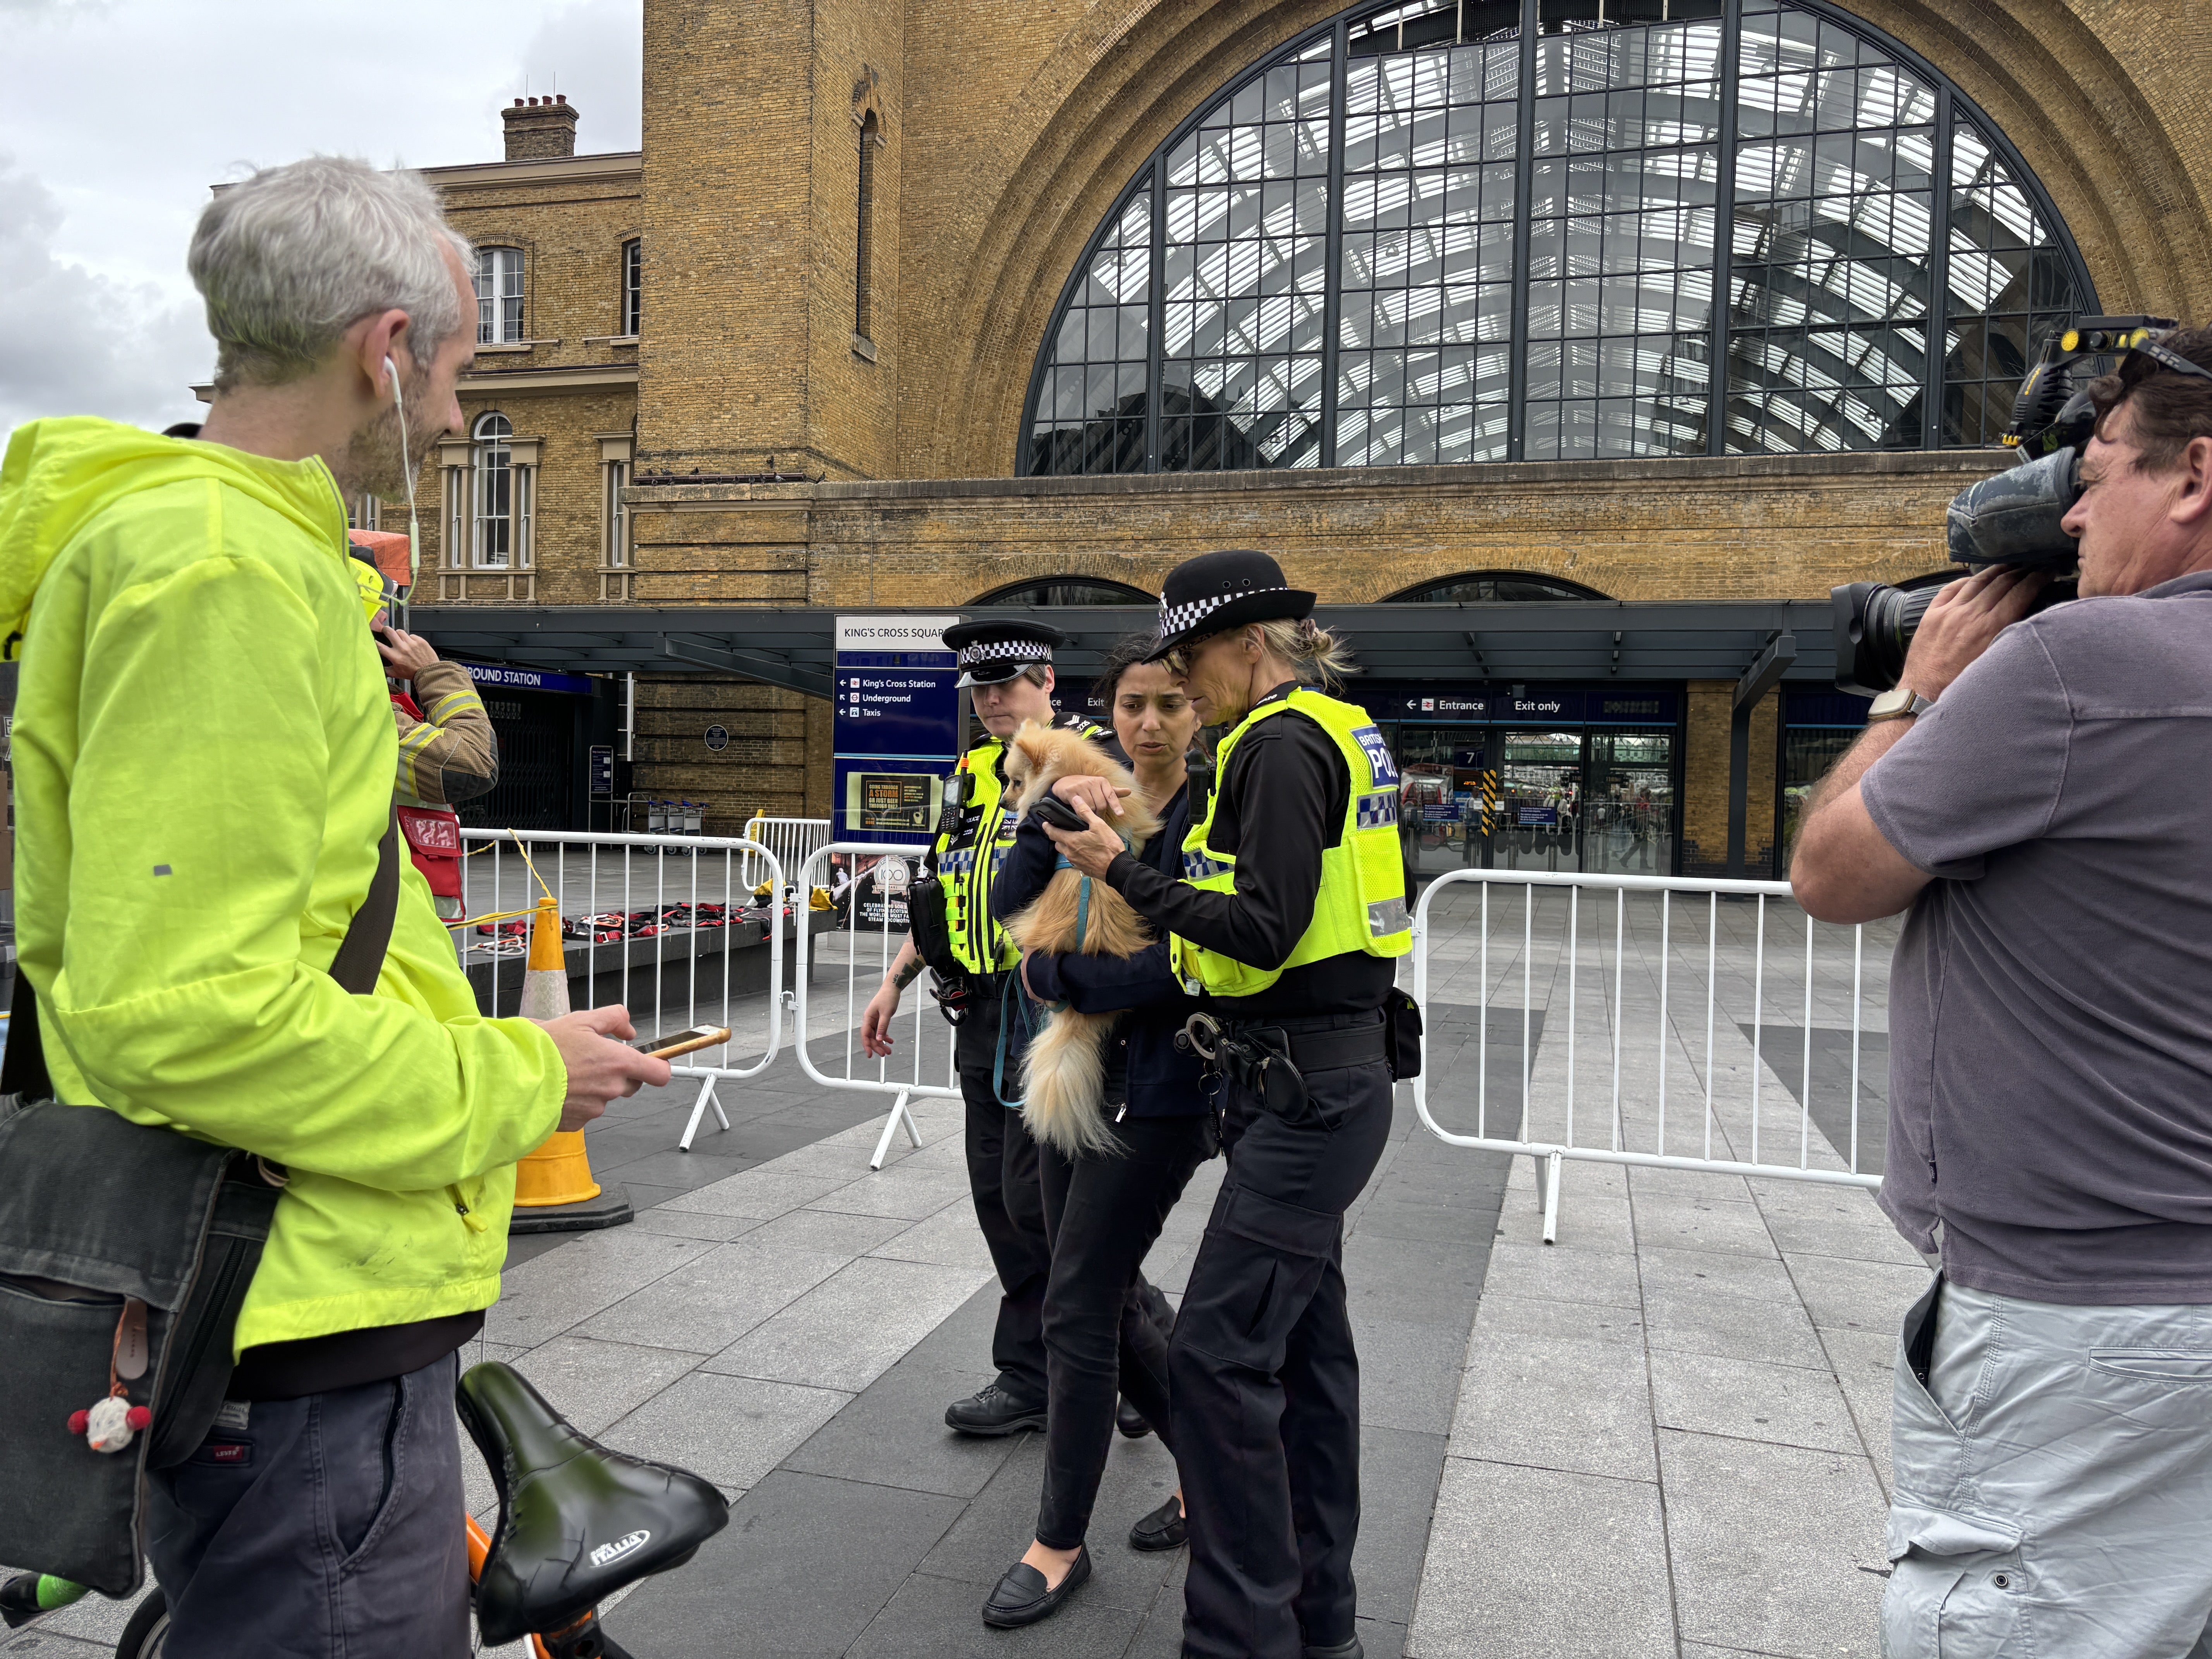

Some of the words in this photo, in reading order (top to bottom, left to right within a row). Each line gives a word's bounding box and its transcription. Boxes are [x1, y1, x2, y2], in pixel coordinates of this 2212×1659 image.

[845, 628, 875, 637] KING'S
[878, 629, 908, 637] CROSS
[911, 629, 944, 638] SQUAR
[503, 671, 541, 686] STATION
[863, 679, 884, 689] King's
[886, 680, 907, 688] Cross
[862, 694, 911, 704] Underground
[1087, 697, 1105, 706] Exit
[1439, 700, 1484, 710] Entrance
[1515, 701, 1535, 711] Exit
[1538, 701, 1561, 713] only
[1467, 752, 1475, 764] 7
[875, 790, 898, 798] STORM
[881, 869, 903, 881] 100
